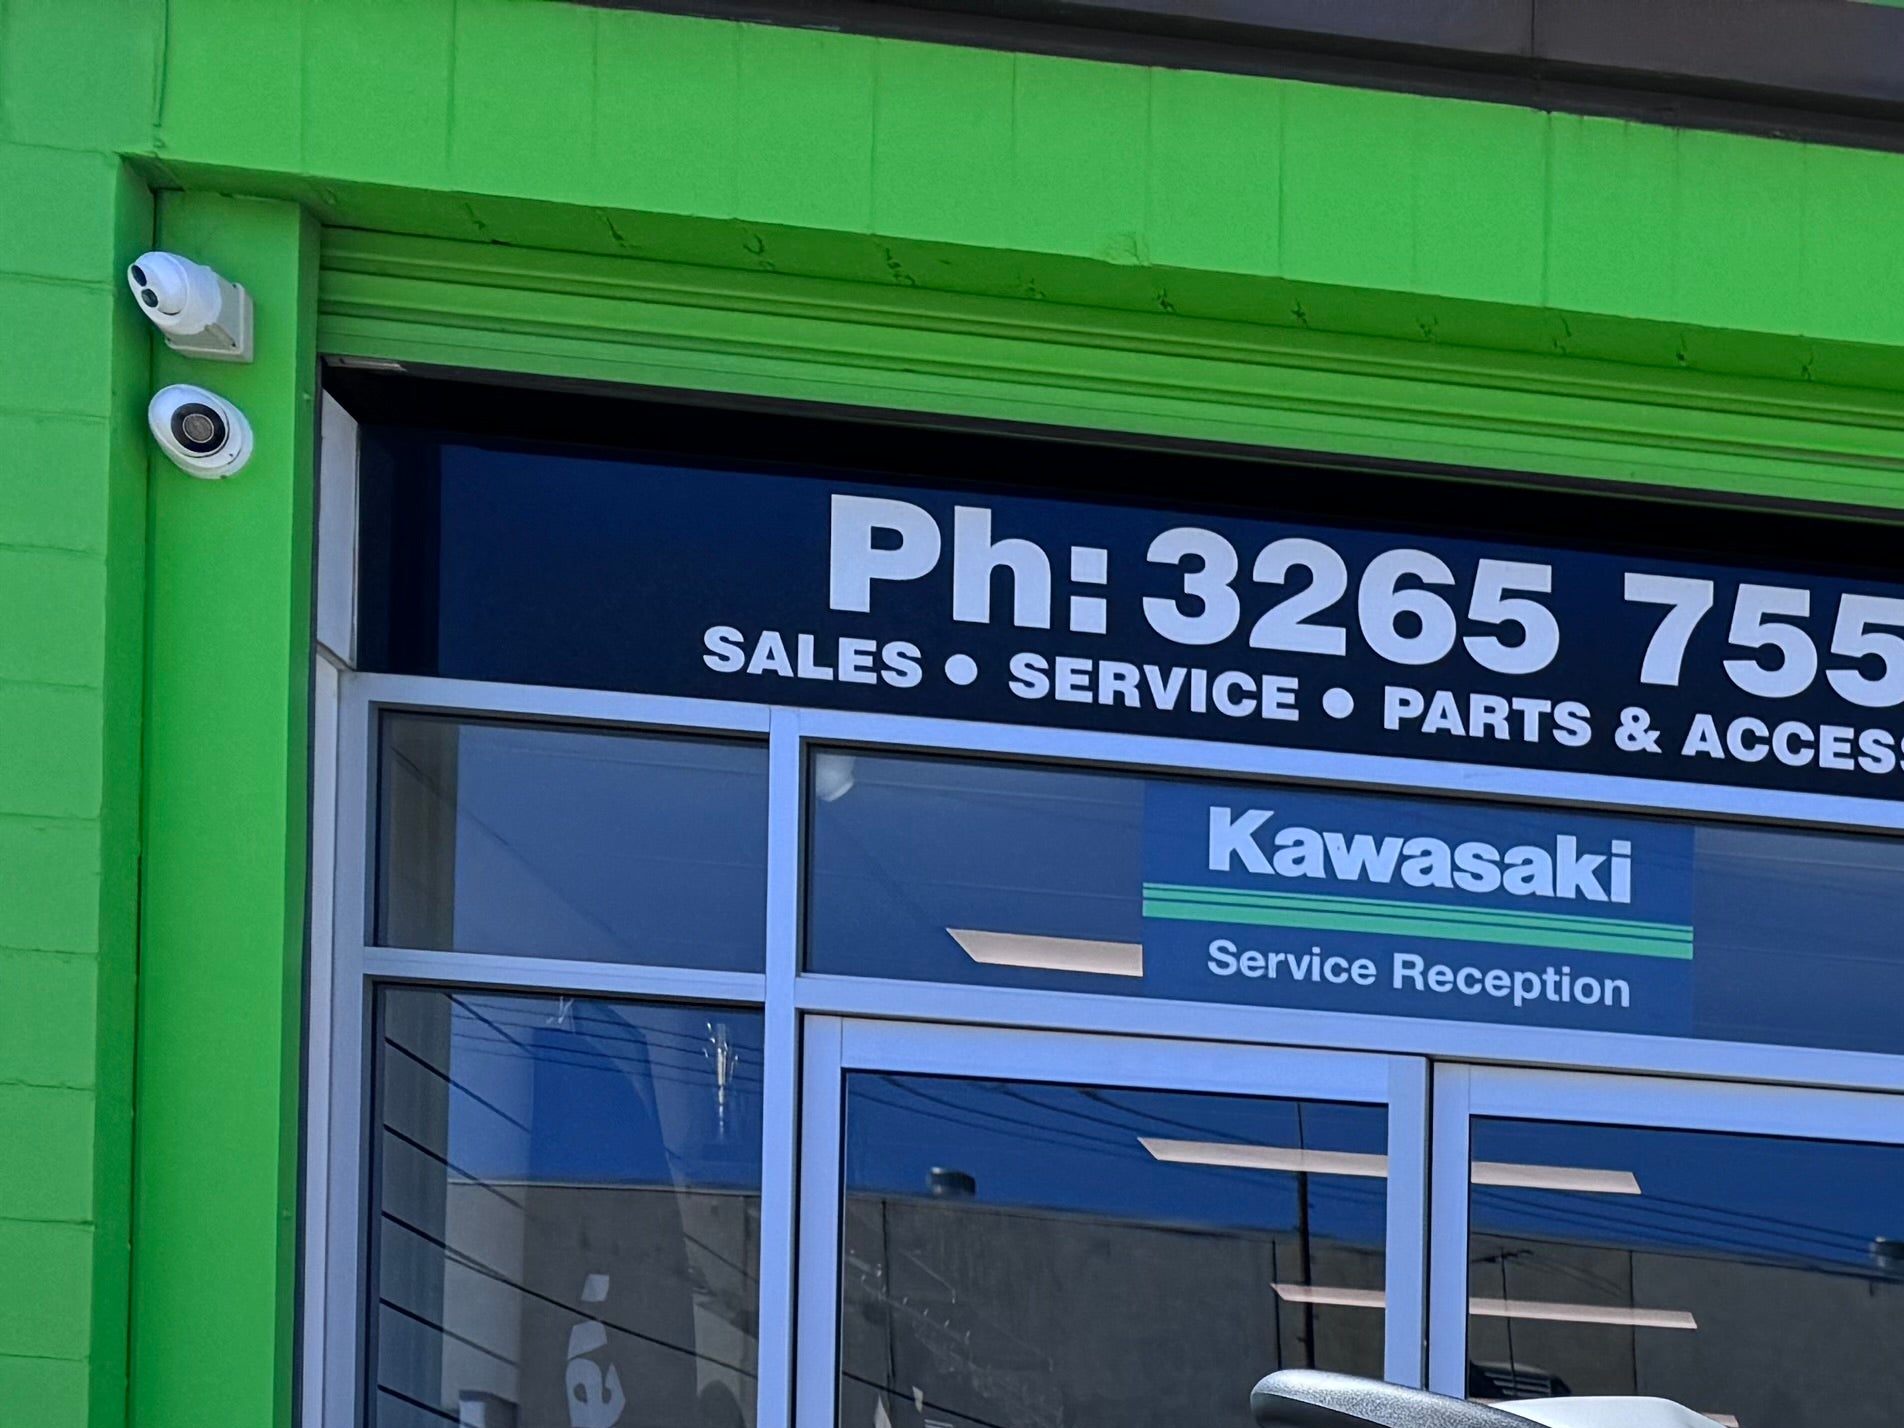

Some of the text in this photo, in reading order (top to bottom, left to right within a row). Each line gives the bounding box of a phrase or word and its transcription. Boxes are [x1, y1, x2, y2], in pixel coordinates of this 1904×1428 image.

[829, 494, 1108, 635] Ph:
[1142, 526, 1561, 676] 3265
[702, 625, 924, 688] SALES
[1008, 652, 1299, 724] SERVICE
[1384, 684, 1592, 748] PARTS
[1614, 707, 1662, 755] &
[1207, 808, 1633, 905] Kawasaki
[1207, 938, 1632, 1010] Service Reception
